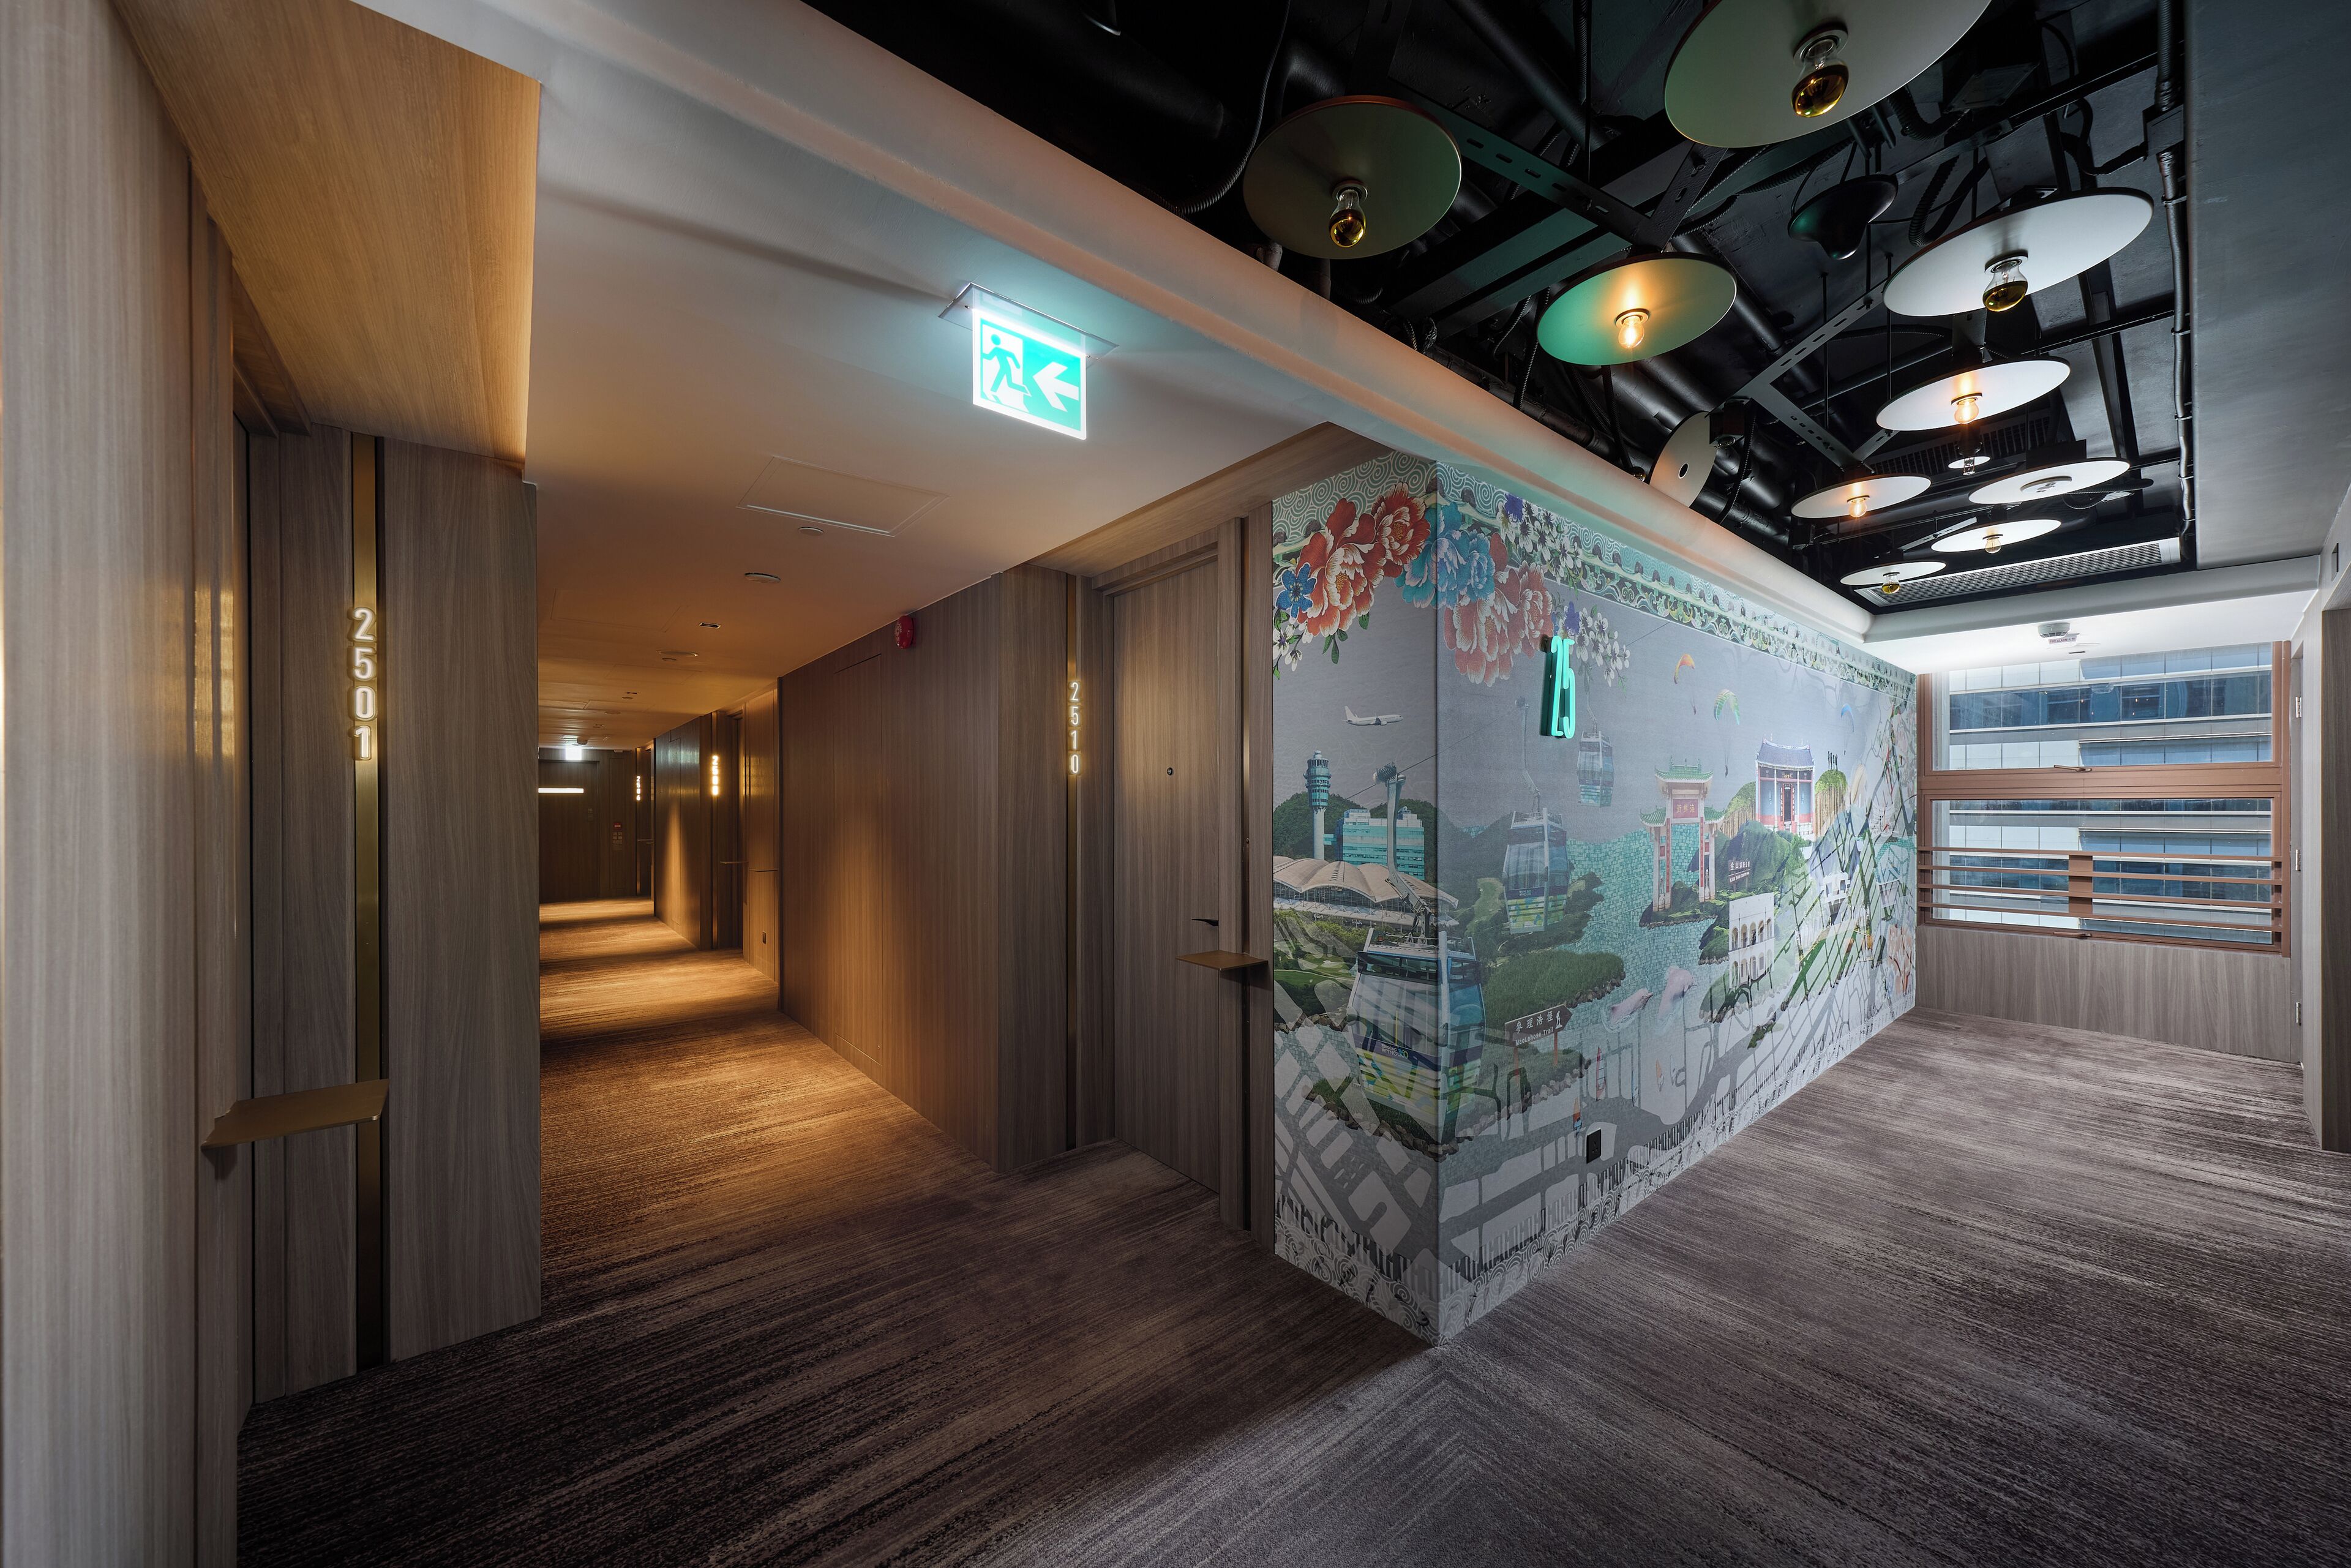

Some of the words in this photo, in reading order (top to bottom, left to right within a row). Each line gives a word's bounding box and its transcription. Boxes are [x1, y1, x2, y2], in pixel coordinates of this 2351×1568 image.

[349, 607, 377, 760] 2501
[1070, 681, 1079, 775] 2510
[1551, 635, 1576, 739] 25
[1543, 1026, 1554, 1036] Trail
